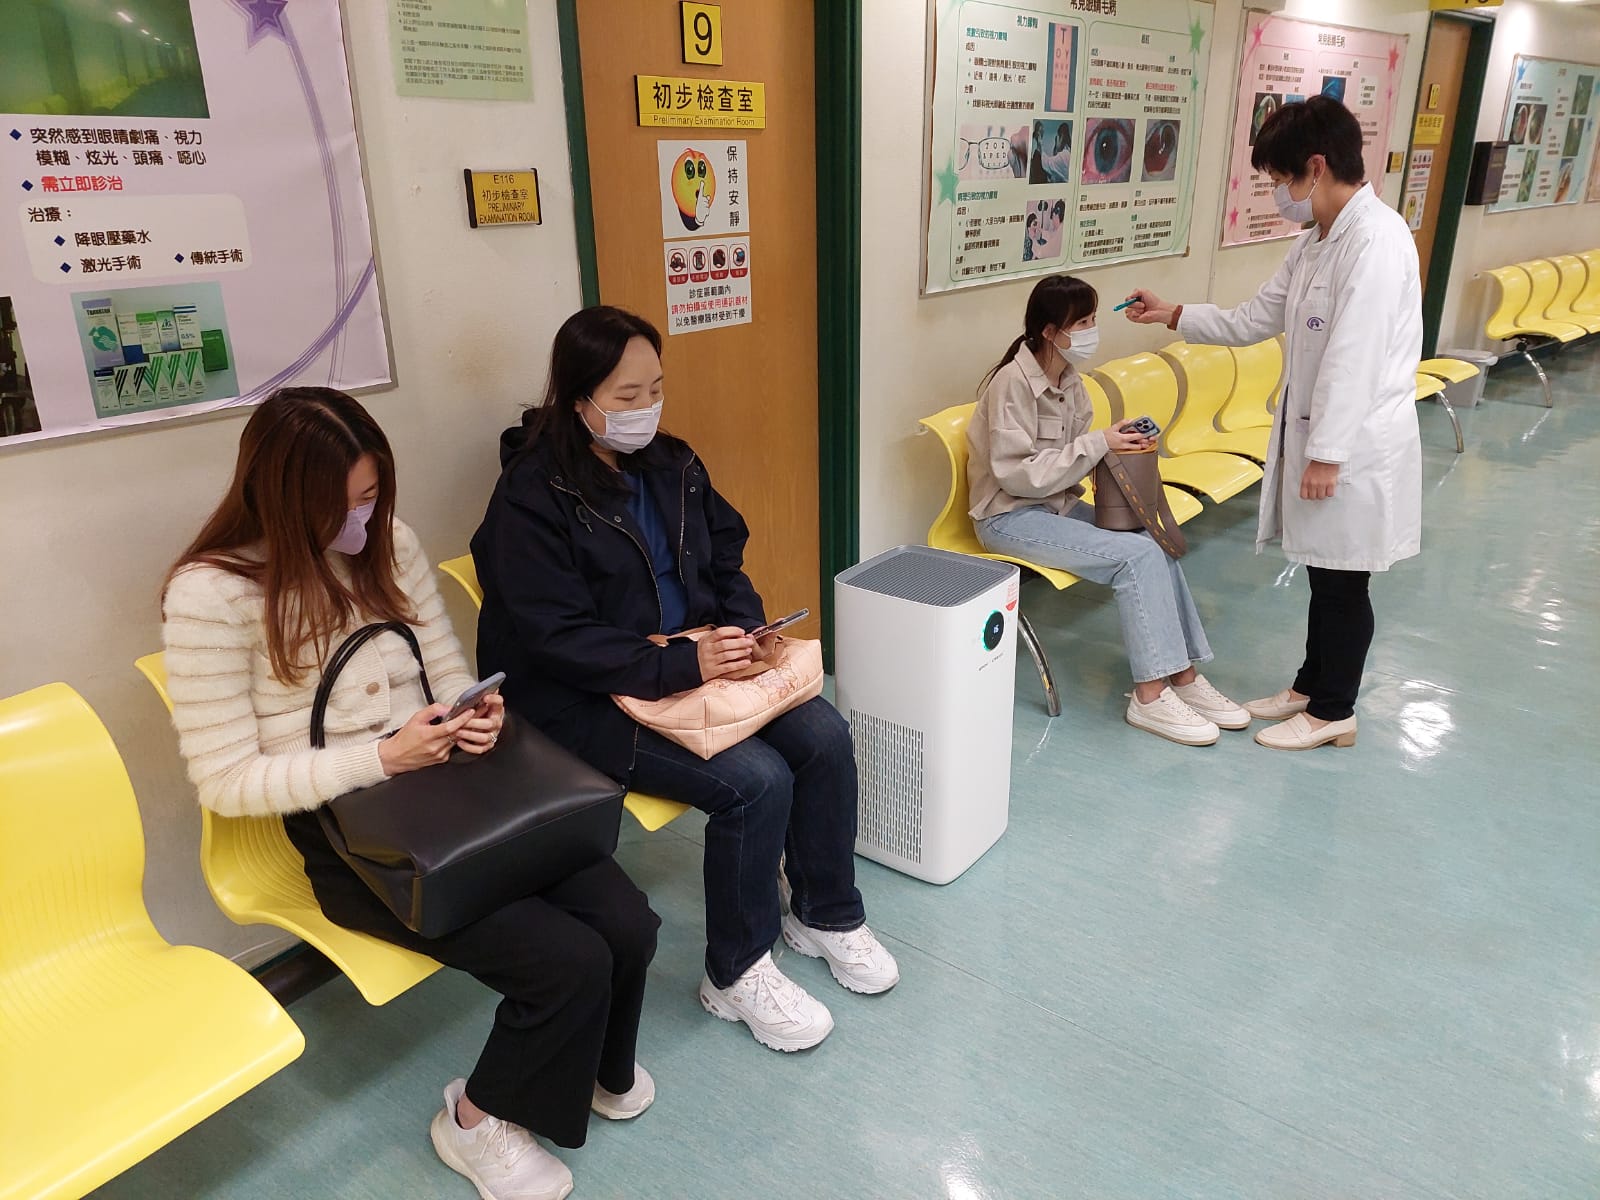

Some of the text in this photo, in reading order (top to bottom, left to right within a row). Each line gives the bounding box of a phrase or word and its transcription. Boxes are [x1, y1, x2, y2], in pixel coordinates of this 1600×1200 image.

[693, 12, 713, 56] 9
[653, 82, 754, 112] 初步檢查室
[653, 115, 755, 127] Preliminary Examination Room
[29, 128, 202, 145] 突然感到眼睛劇痛、視力
[41, 175, 123, 193] 需立即診治
[493, 174, 515, 184] E116
[726, 145, 740, 227] 保持安靜
[482, 189, 529, 201] 初步檢查室
[27, 206, 72, 223] 治療：
[487, 202, 525, 213] PRELIMINARY
[479, 212, 536, 224] EXAMINATION ROOM
[74, 229, 152, 247] 降眼壓藥水
[80, 255, 142, 274] 激光手術
[190, 249, 244, 266] 傳統手術
[688, 284, 732, 299] 診症區範圍內
[675, 308, 746, 328] 以免醫療器材受到干擾
